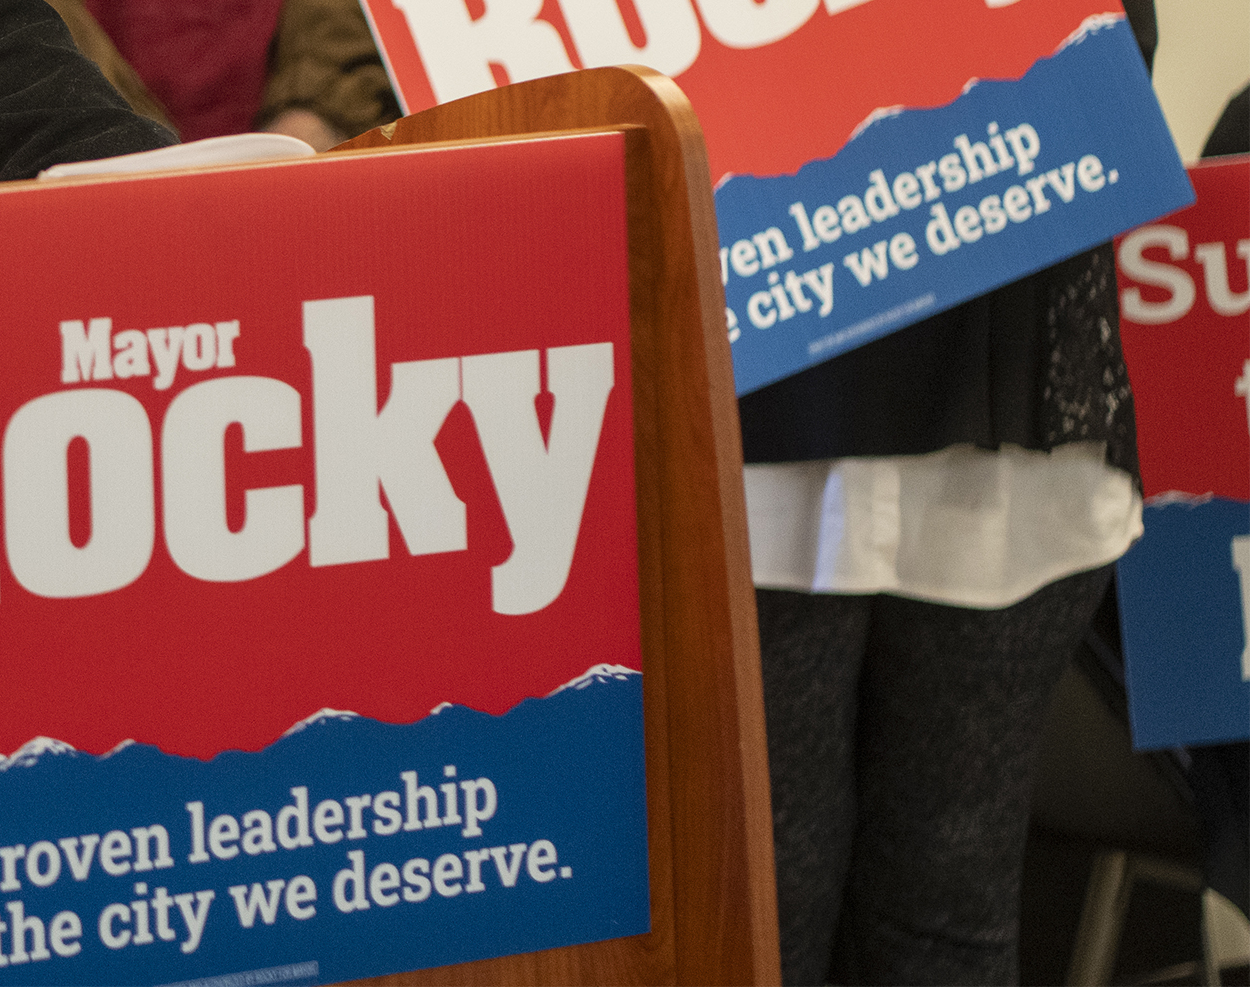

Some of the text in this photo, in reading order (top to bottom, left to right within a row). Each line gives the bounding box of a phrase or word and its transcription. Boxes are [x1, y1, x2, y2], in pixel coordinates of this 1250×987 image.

[747, 262, 835, 330] city
[844, 232, 920, 287] we
[925, 154, 1120, 256] deserve.
[789, 122, 1041, 253] leadership
[59, 317, 240, 391] Mayor
[187, 765, 499, 865] leadership
[97, 882, 217, 954] city
[229, 874, 318, 927] we
[331, 837, 573, 911] deserve.
